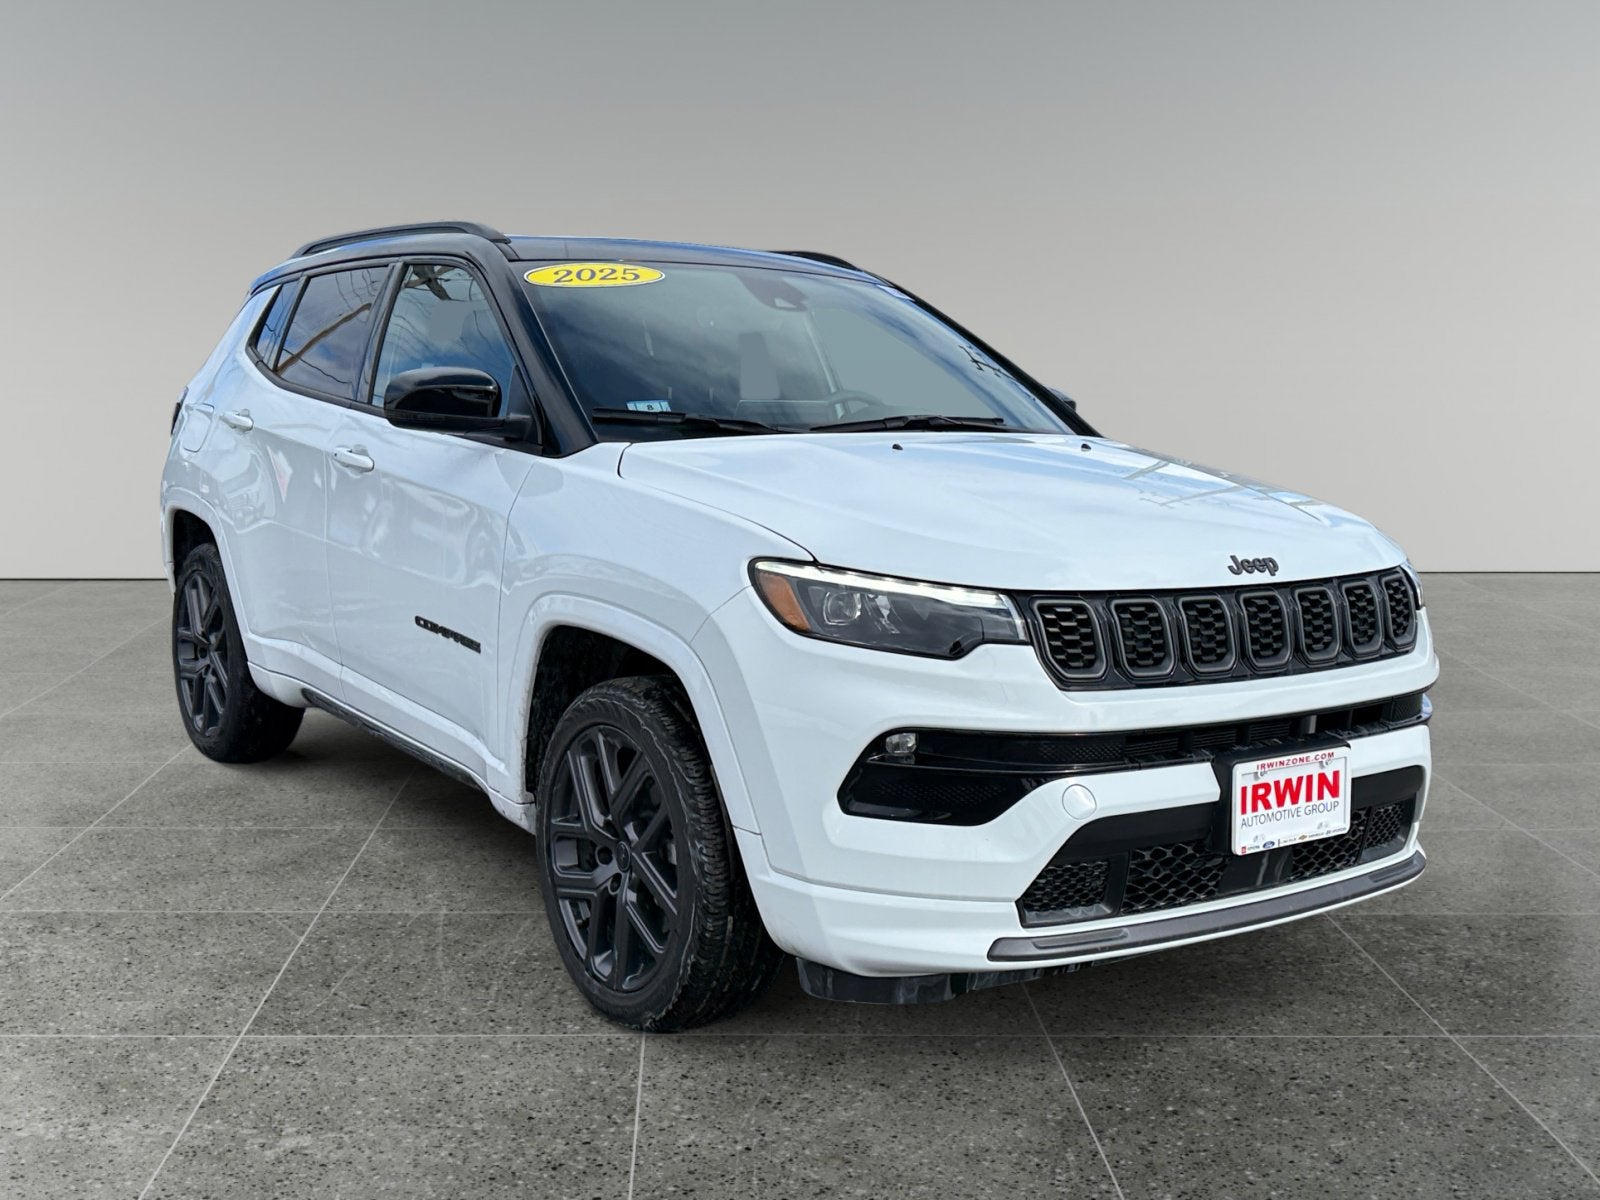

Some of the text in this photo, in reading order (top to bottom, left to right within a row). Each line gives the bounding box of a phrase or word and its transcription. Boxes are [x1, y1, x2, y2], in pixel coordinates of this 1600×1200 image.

[553, 267, 640, 284] 2025
[1227, 555, 1279, 577] Jeep
[1256, 751, 1335, 771] IRWINZONE.COM
[1240, 770, 1340, 816] IRWIN
[1240, 800, 1340, 829] AUTOMOTIVE GROUP
